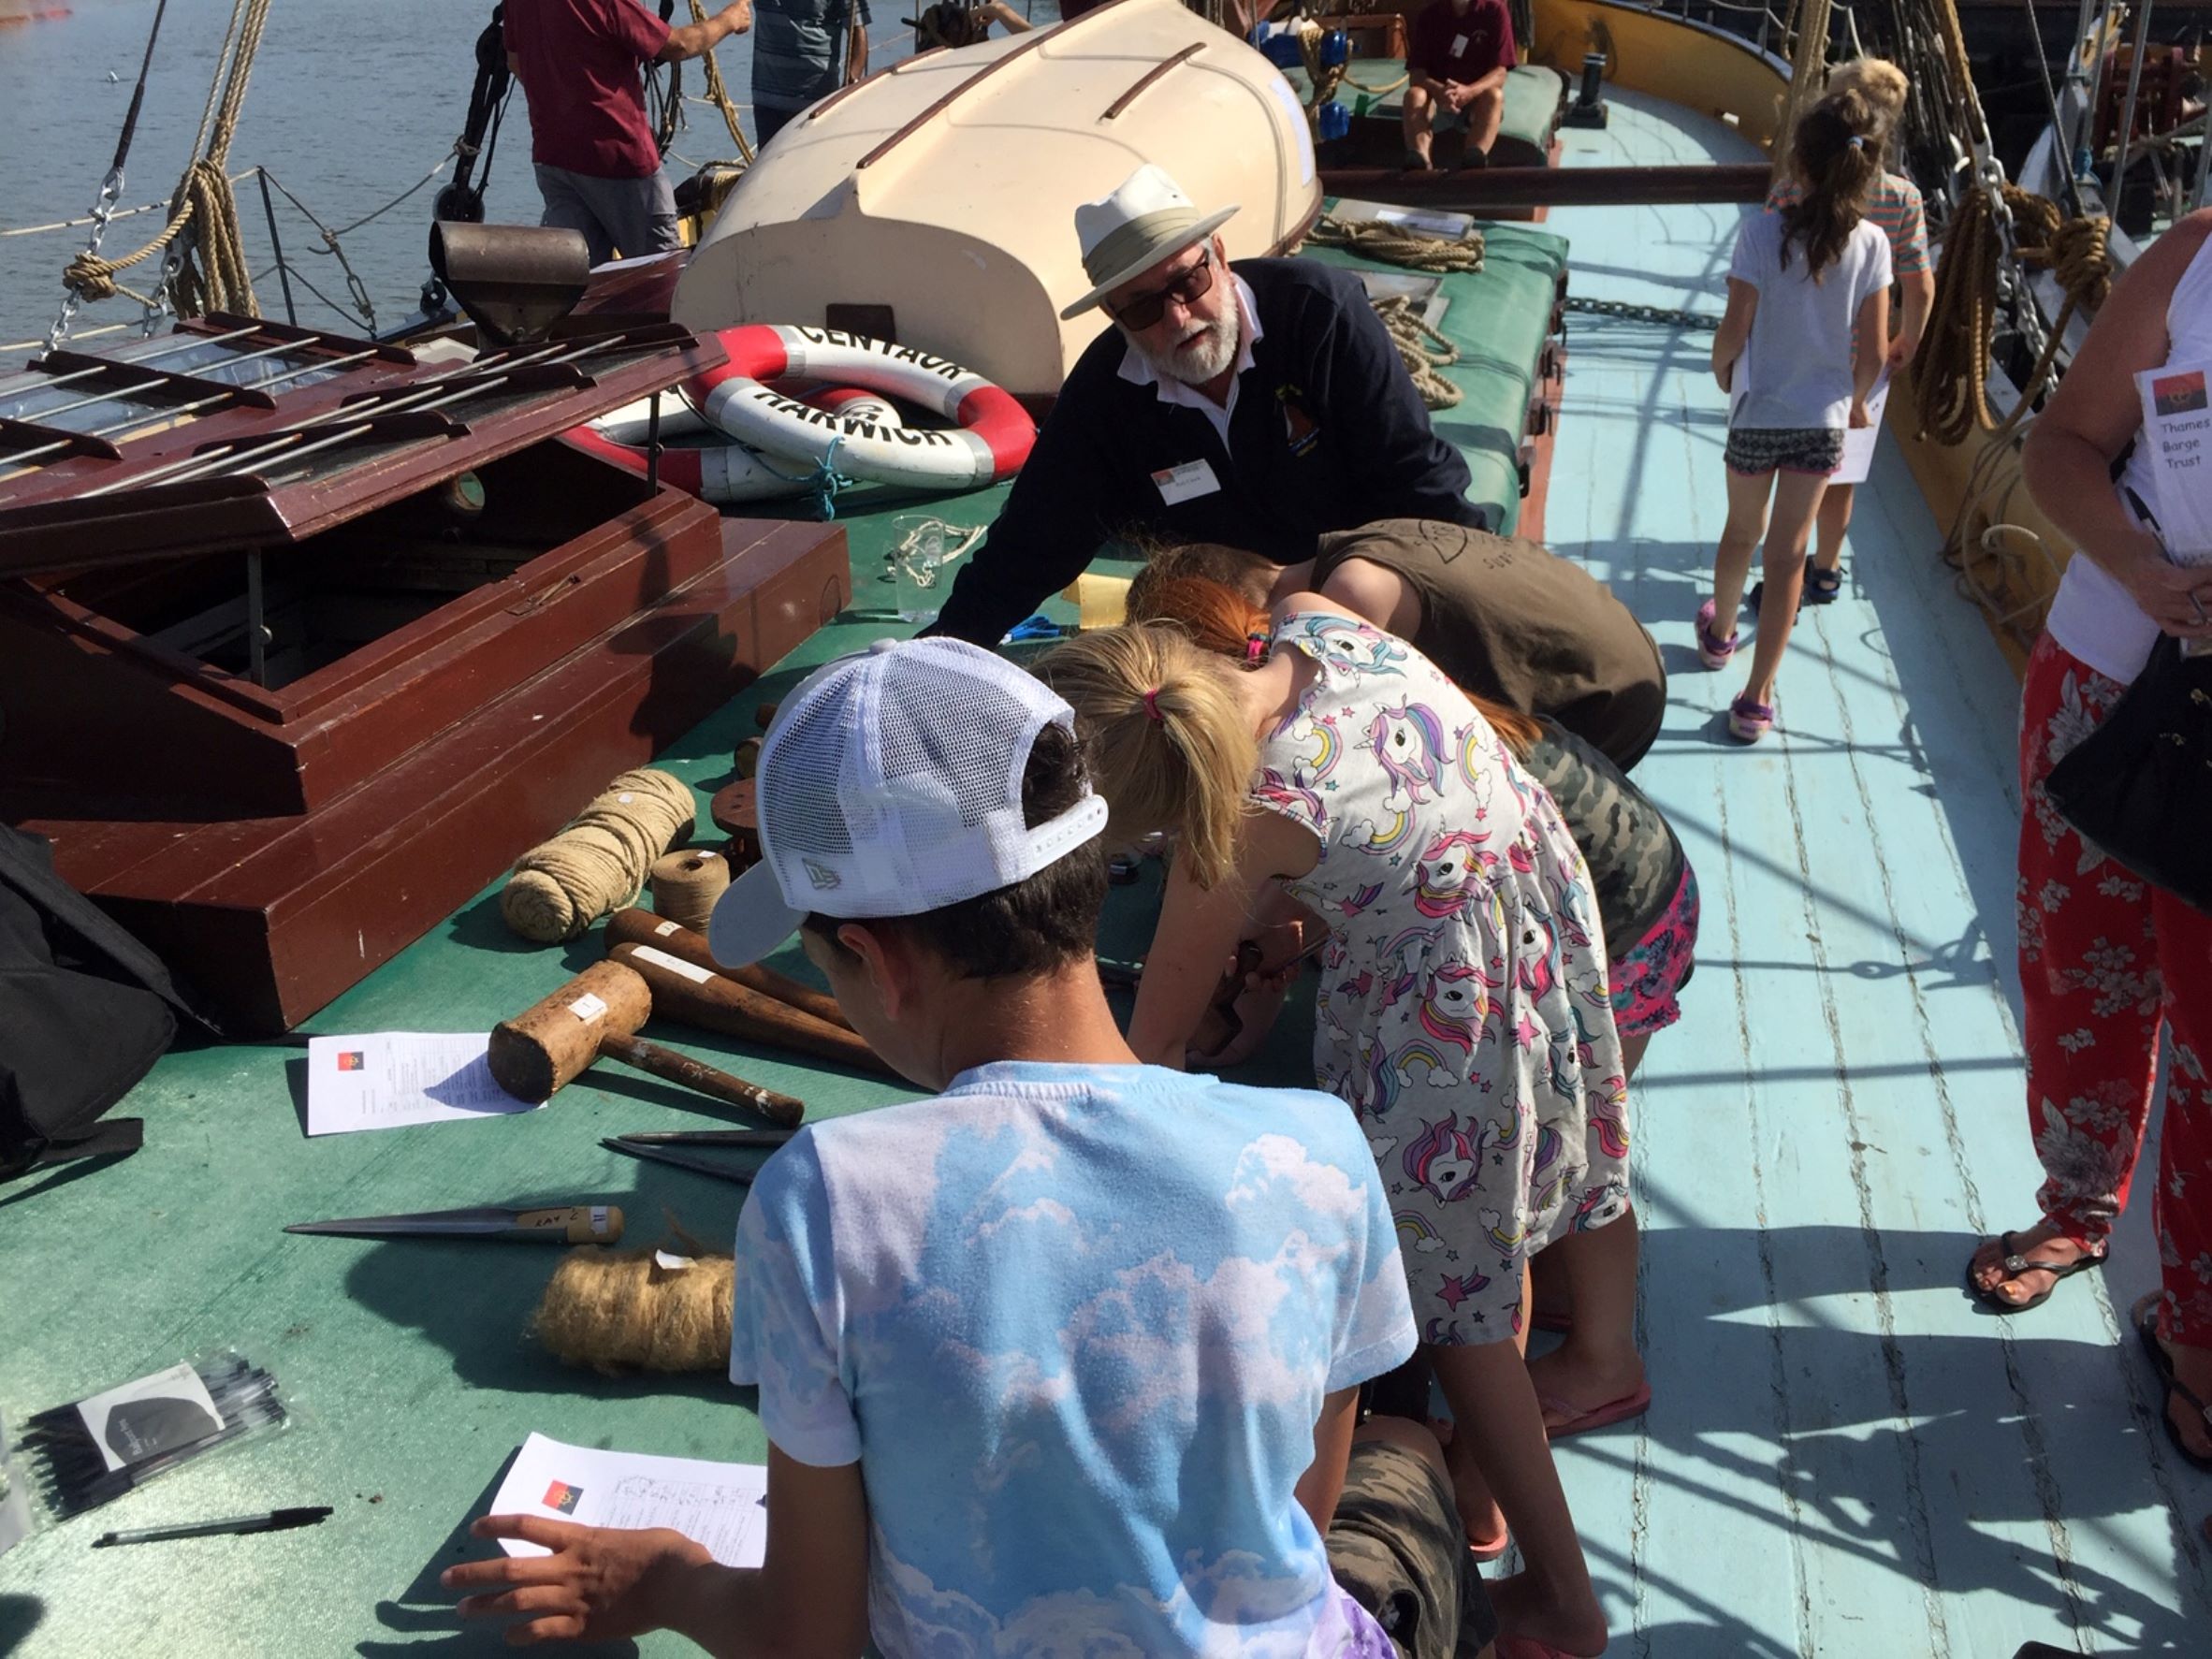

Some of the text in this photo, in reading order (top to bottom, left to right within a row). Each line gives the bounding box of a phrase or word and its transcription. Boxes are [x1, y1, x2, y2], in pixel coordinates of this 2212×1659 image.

[2161, 417, 2211, 433] Thames
[2162, 440, 2201, 454] Barge
[2165, 455, 2201, 469] Trust
